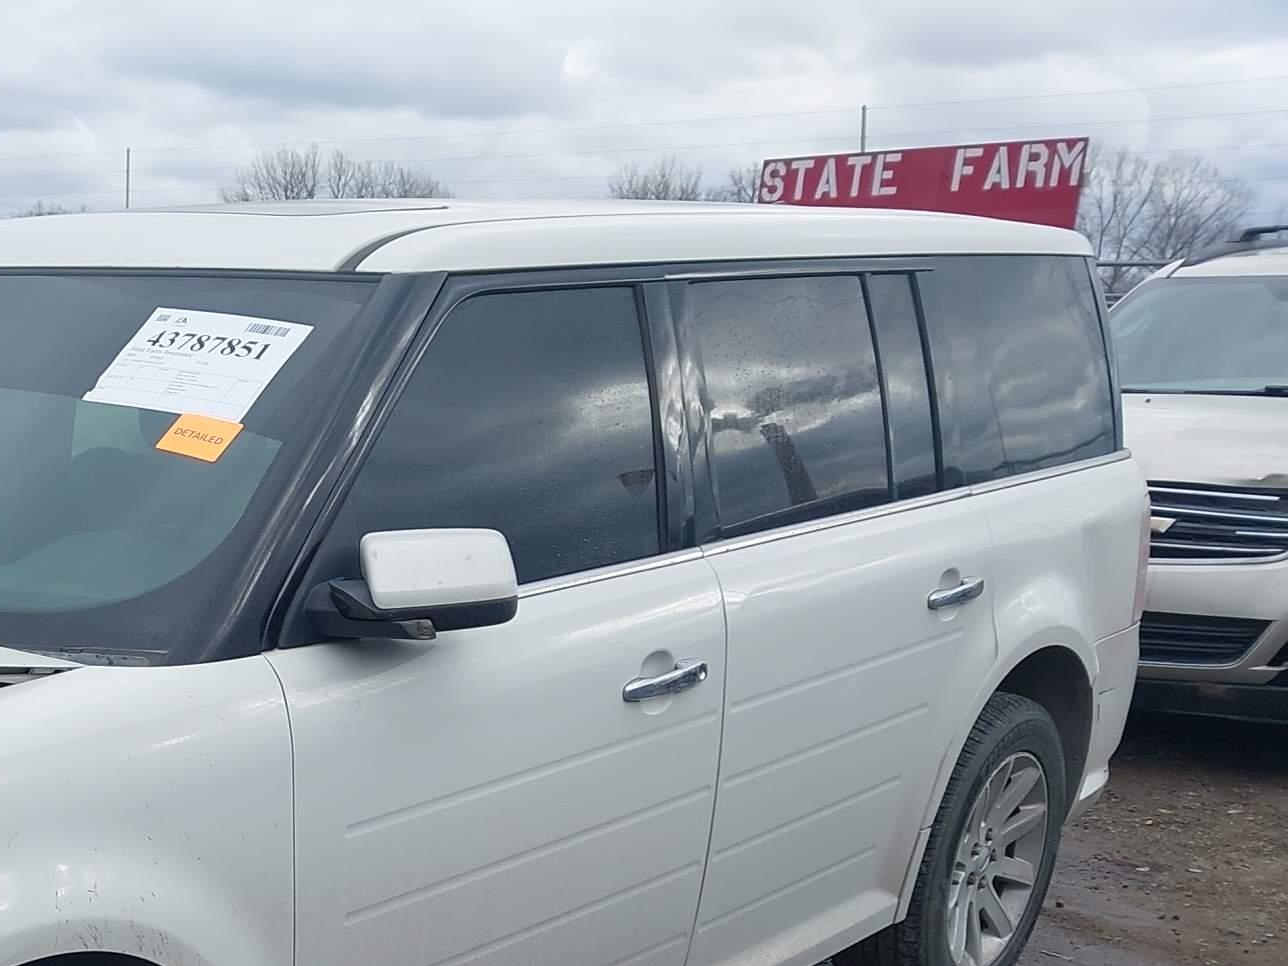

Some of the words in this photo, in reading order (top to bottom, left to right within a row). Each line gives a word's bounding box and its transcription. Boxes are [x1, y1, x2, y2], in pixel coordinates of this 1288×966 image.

[761, 152, 902, 202] STATE
[950, 140, 1085, 192] FARM
[146, 330, 271, 361] 43787851
[173, 427, 224, 445] DETAILED
